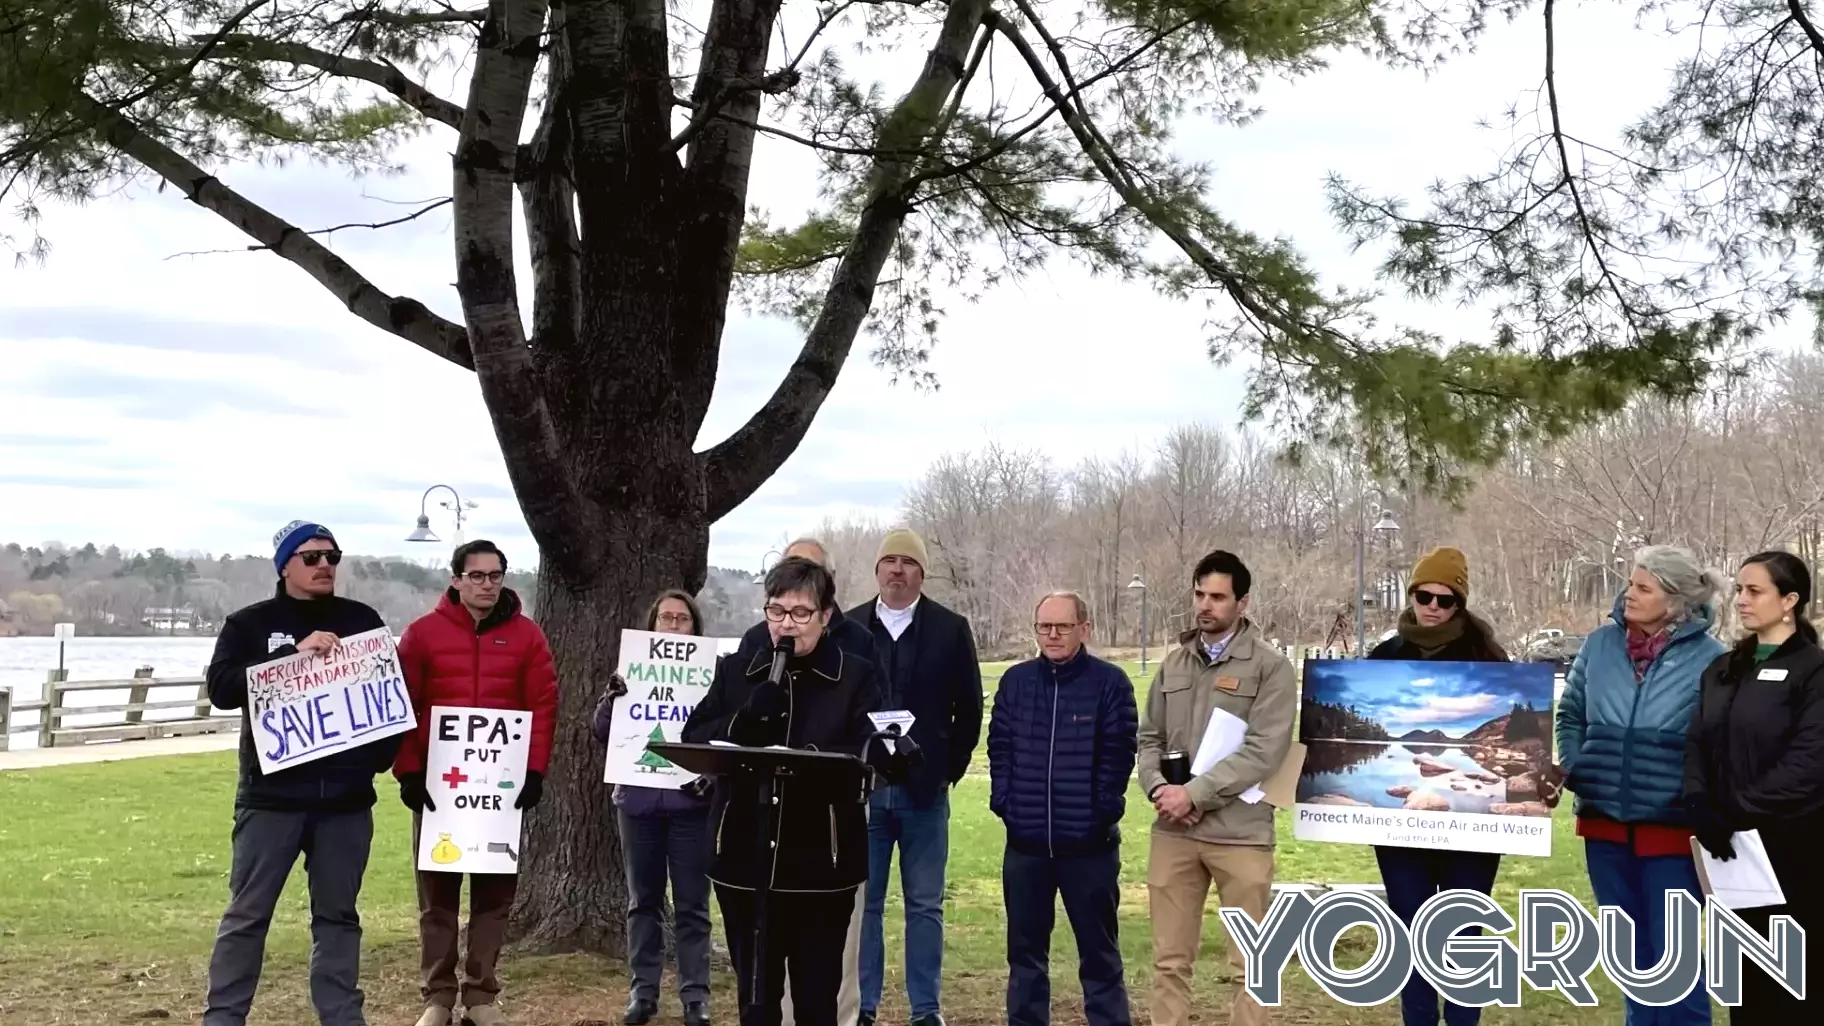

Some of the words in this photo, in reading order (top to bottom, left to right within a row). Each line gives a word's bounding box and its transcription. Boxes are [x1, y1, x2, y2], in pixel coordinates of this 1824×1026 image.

[257, 654, 314, 689] MERCURY
[324, 634, 388, 666] EMISSIONS
[649, 637, 698, 662] KEEP
[284, 658, 369, 695] STANDARDS
[626, 662, 713, 688] MAINE'S
[647, 686, 675, 701] AIR
[262, 693, 341, 761] SAVE
[344, 677, 408, 731] LIVES
[629, 703, 694, 722] CLEAN
[438, 714, 523, 745] EPA:
[464, 748, 502, 763] PUT
[454, 795, 502, 811] OVER
[1300, 809, 1348, 824] Protect
[1352, 813, 1403, 827] Maine's
[1406, 816, 1445, 829] Clean
[1449, 819, 1468, 831] Air
[1472, 822, 1498, 833] and
[1502, 822, 1544, 836] Water
[1387, 832, 1410, 842] Fund
[1431, 835, 1450, 844] EPA
